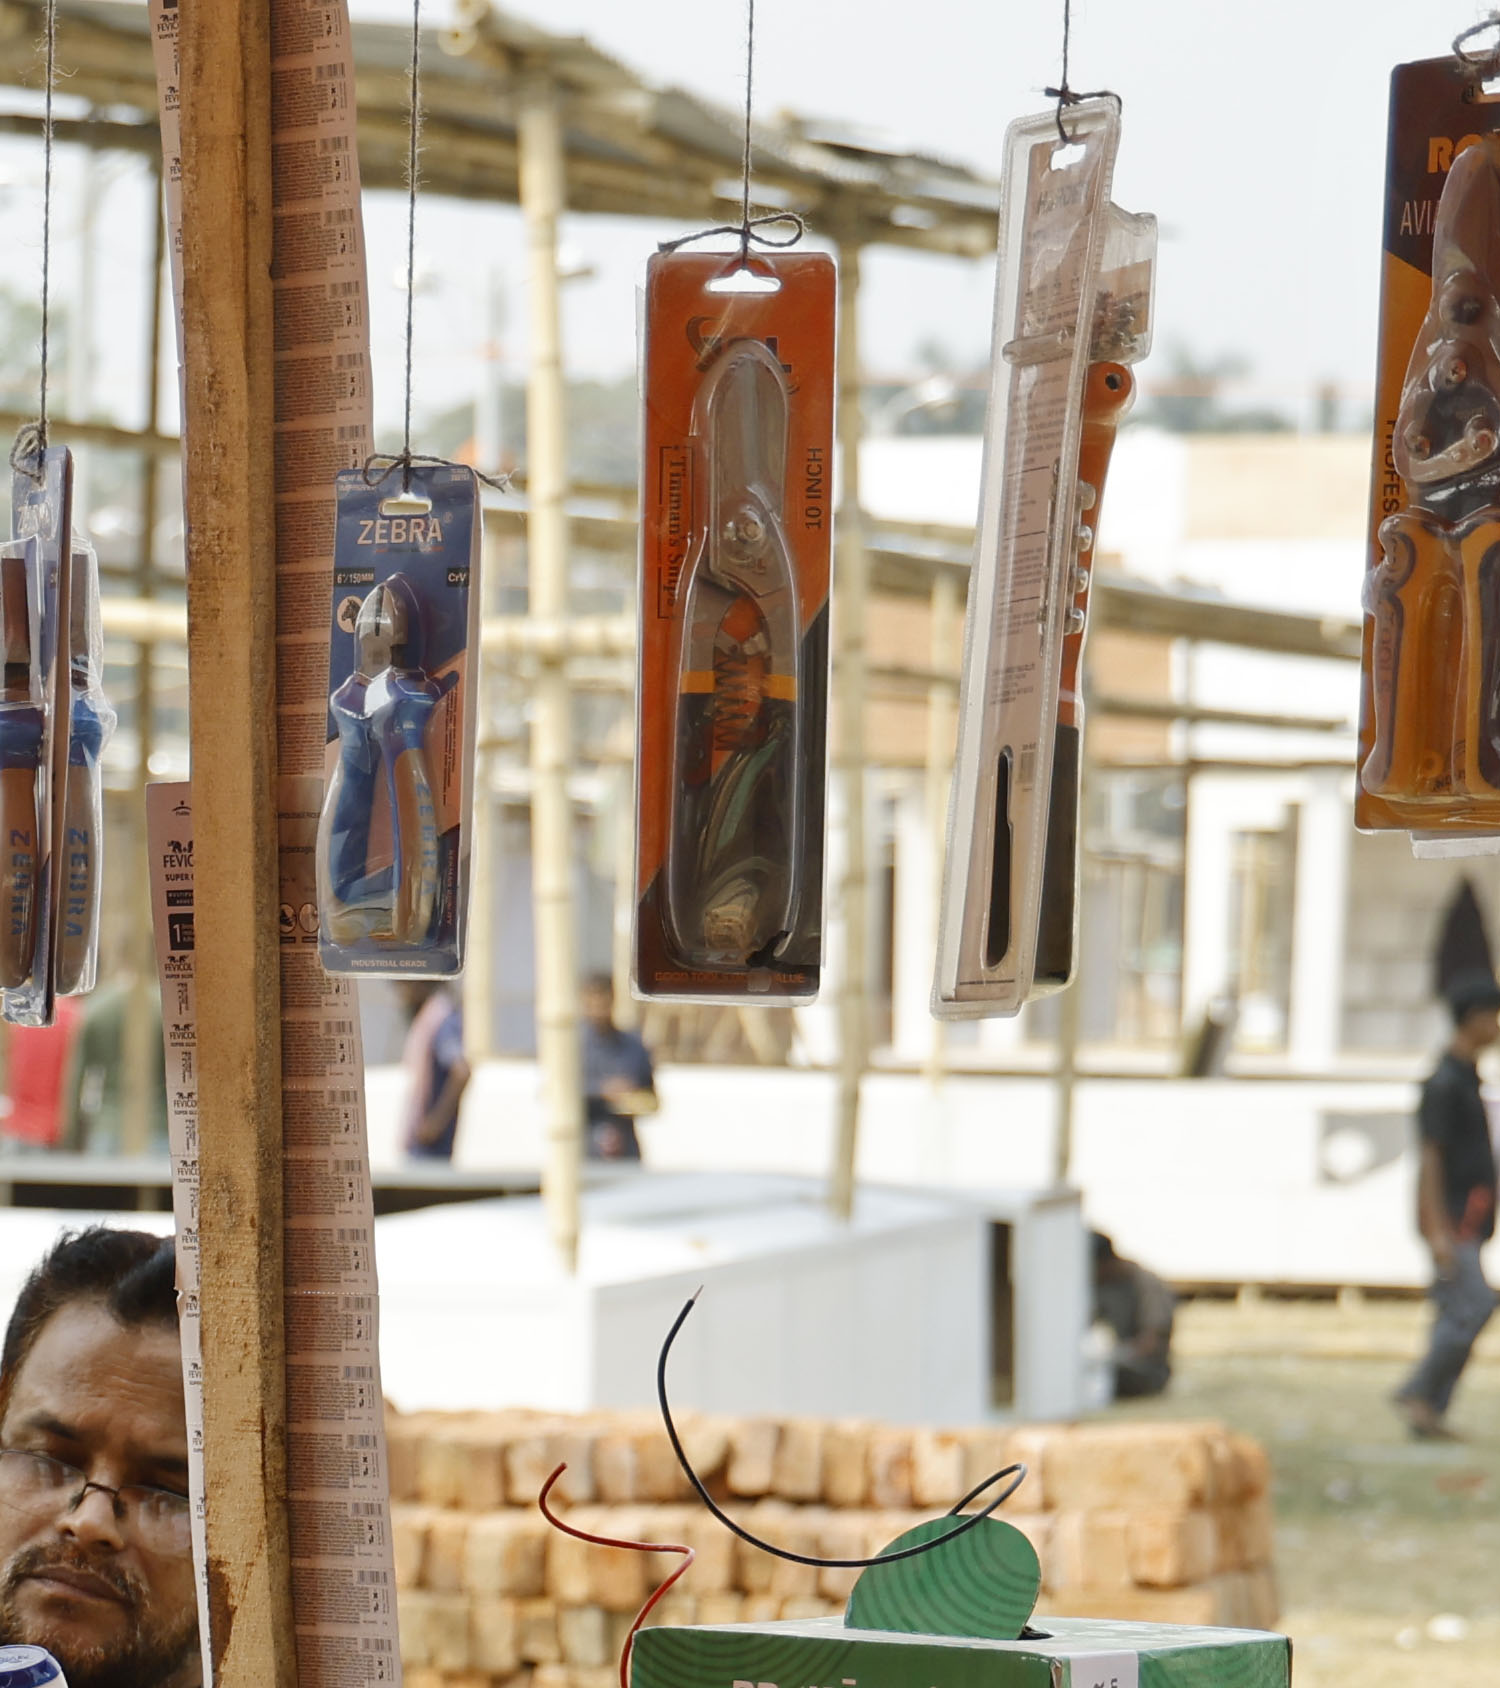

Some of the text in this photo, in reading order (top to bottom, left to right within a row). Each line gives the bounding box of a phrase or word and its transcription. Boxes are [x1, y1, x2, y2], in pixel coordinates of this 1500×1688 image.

[806, 447, 823, 530] 10 INCH
[357, 516, 444, 546] ZEBRA
[449, 572, 467, 583] CrV
[351, 958, 428, 969] INDUSTRIAL GRADE
